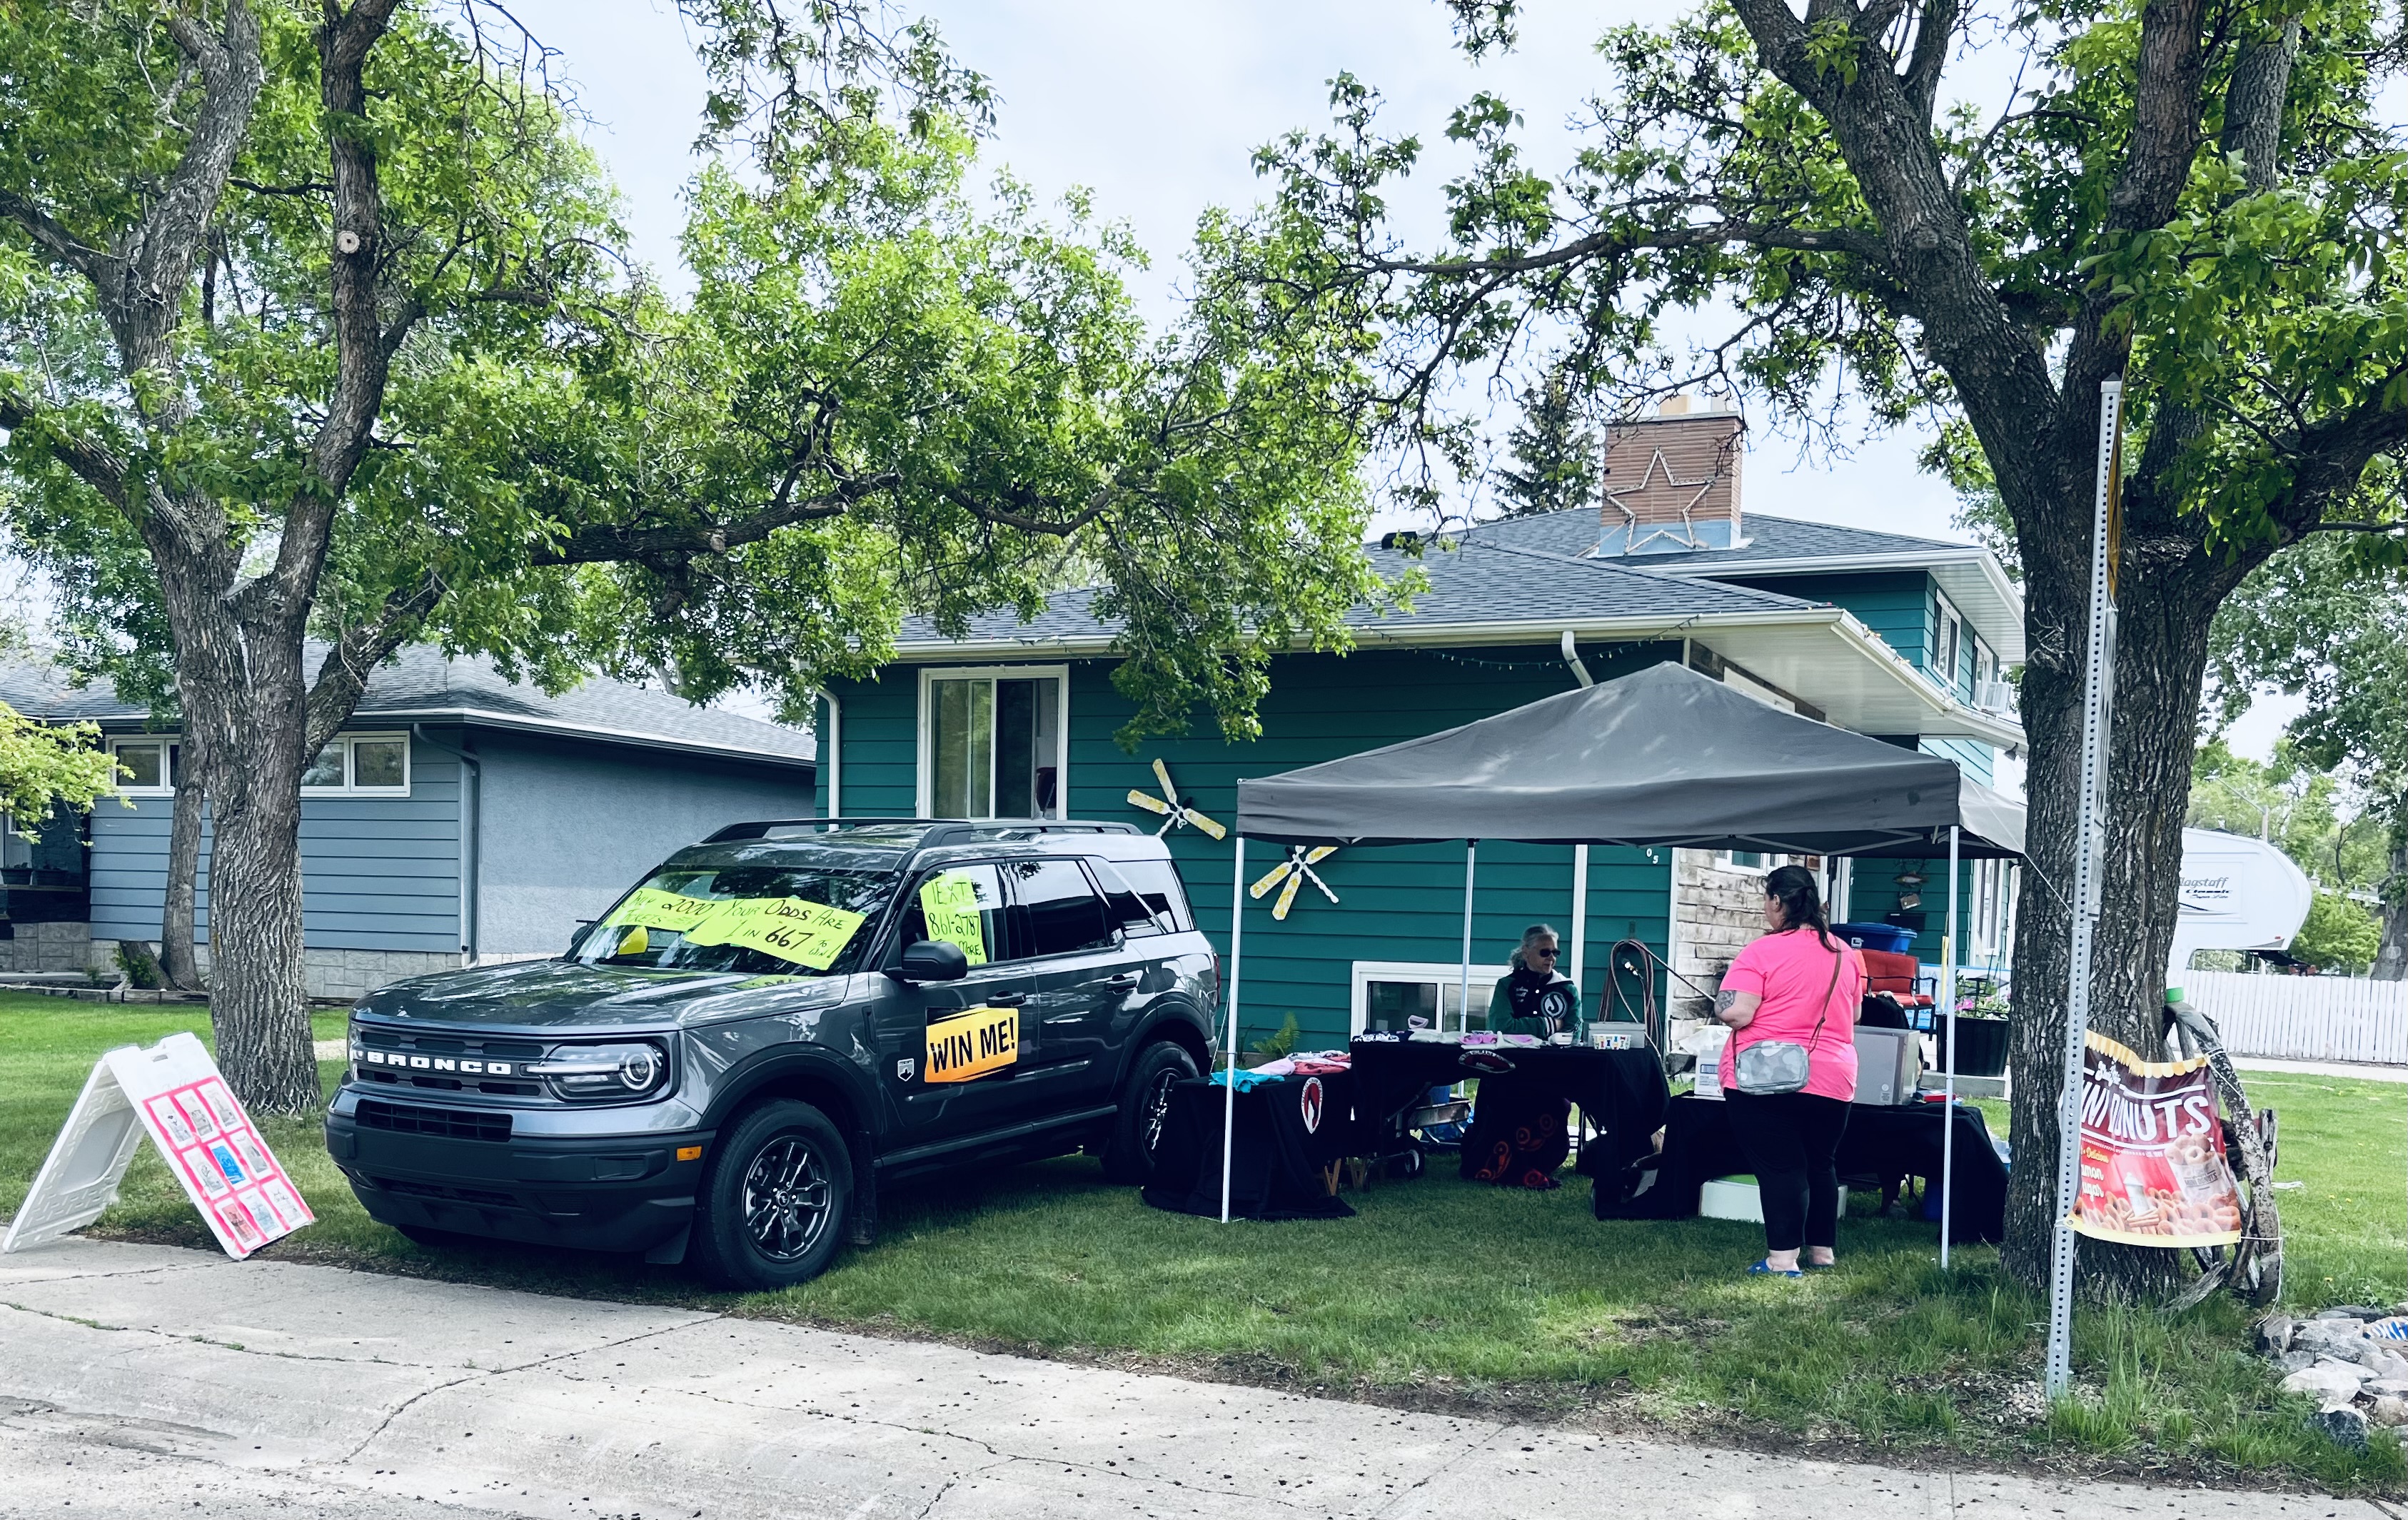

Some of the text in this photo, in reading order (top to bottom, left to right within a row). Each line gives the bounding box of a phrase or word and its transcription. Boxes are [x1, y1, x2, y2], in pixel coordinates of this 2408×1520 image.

[931, 881, 967, 905] TEXT
[2180, 877, 2229, 888] lagstaff
[661, 898, 715, 916] 2000
[764, 899, 812, 921] ODDS
[812, 909, 847, 930] ARE
[929, 912, 979, 937] 861-2787
[765, 925, 815, 950] 667
[930, 1017, 1015, 1074] WIN ME!
[367, 1050, 512, 1076] BRONCO
